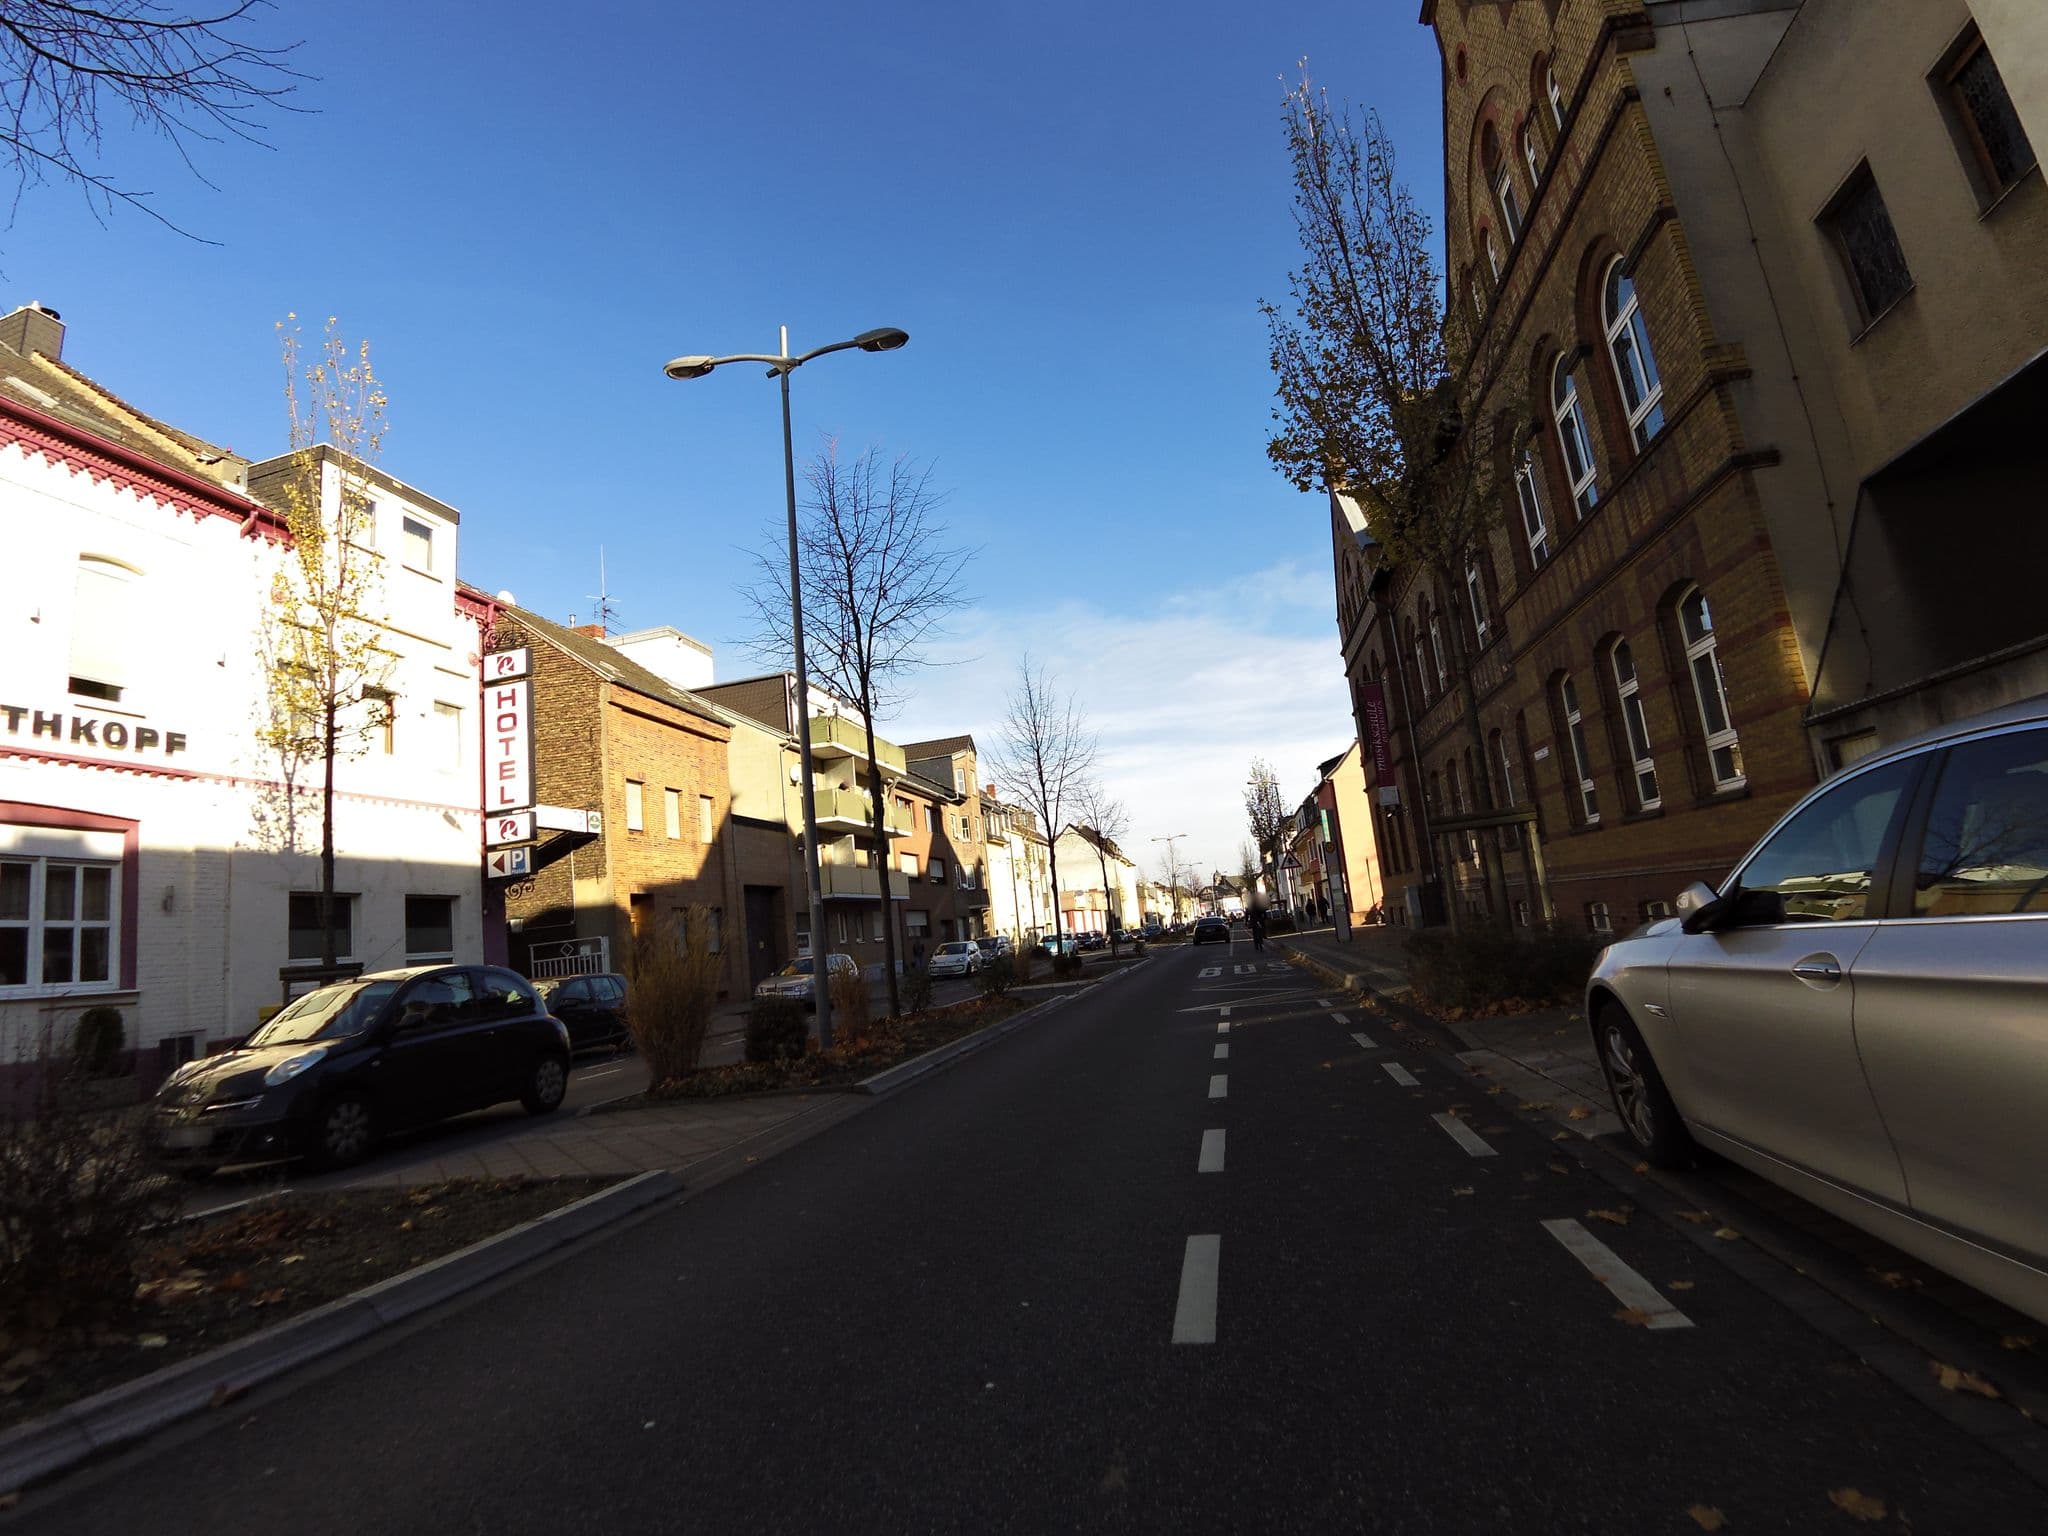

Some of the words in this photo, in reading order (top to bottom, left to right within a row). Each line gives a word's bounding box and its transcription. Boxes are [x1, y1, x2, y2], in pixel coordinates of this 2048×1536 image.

[0, 704, 187, 757] THKOPF
[497, 688, 517, 805] HOTEL
[1198, 962, 1296, 978] BUS
